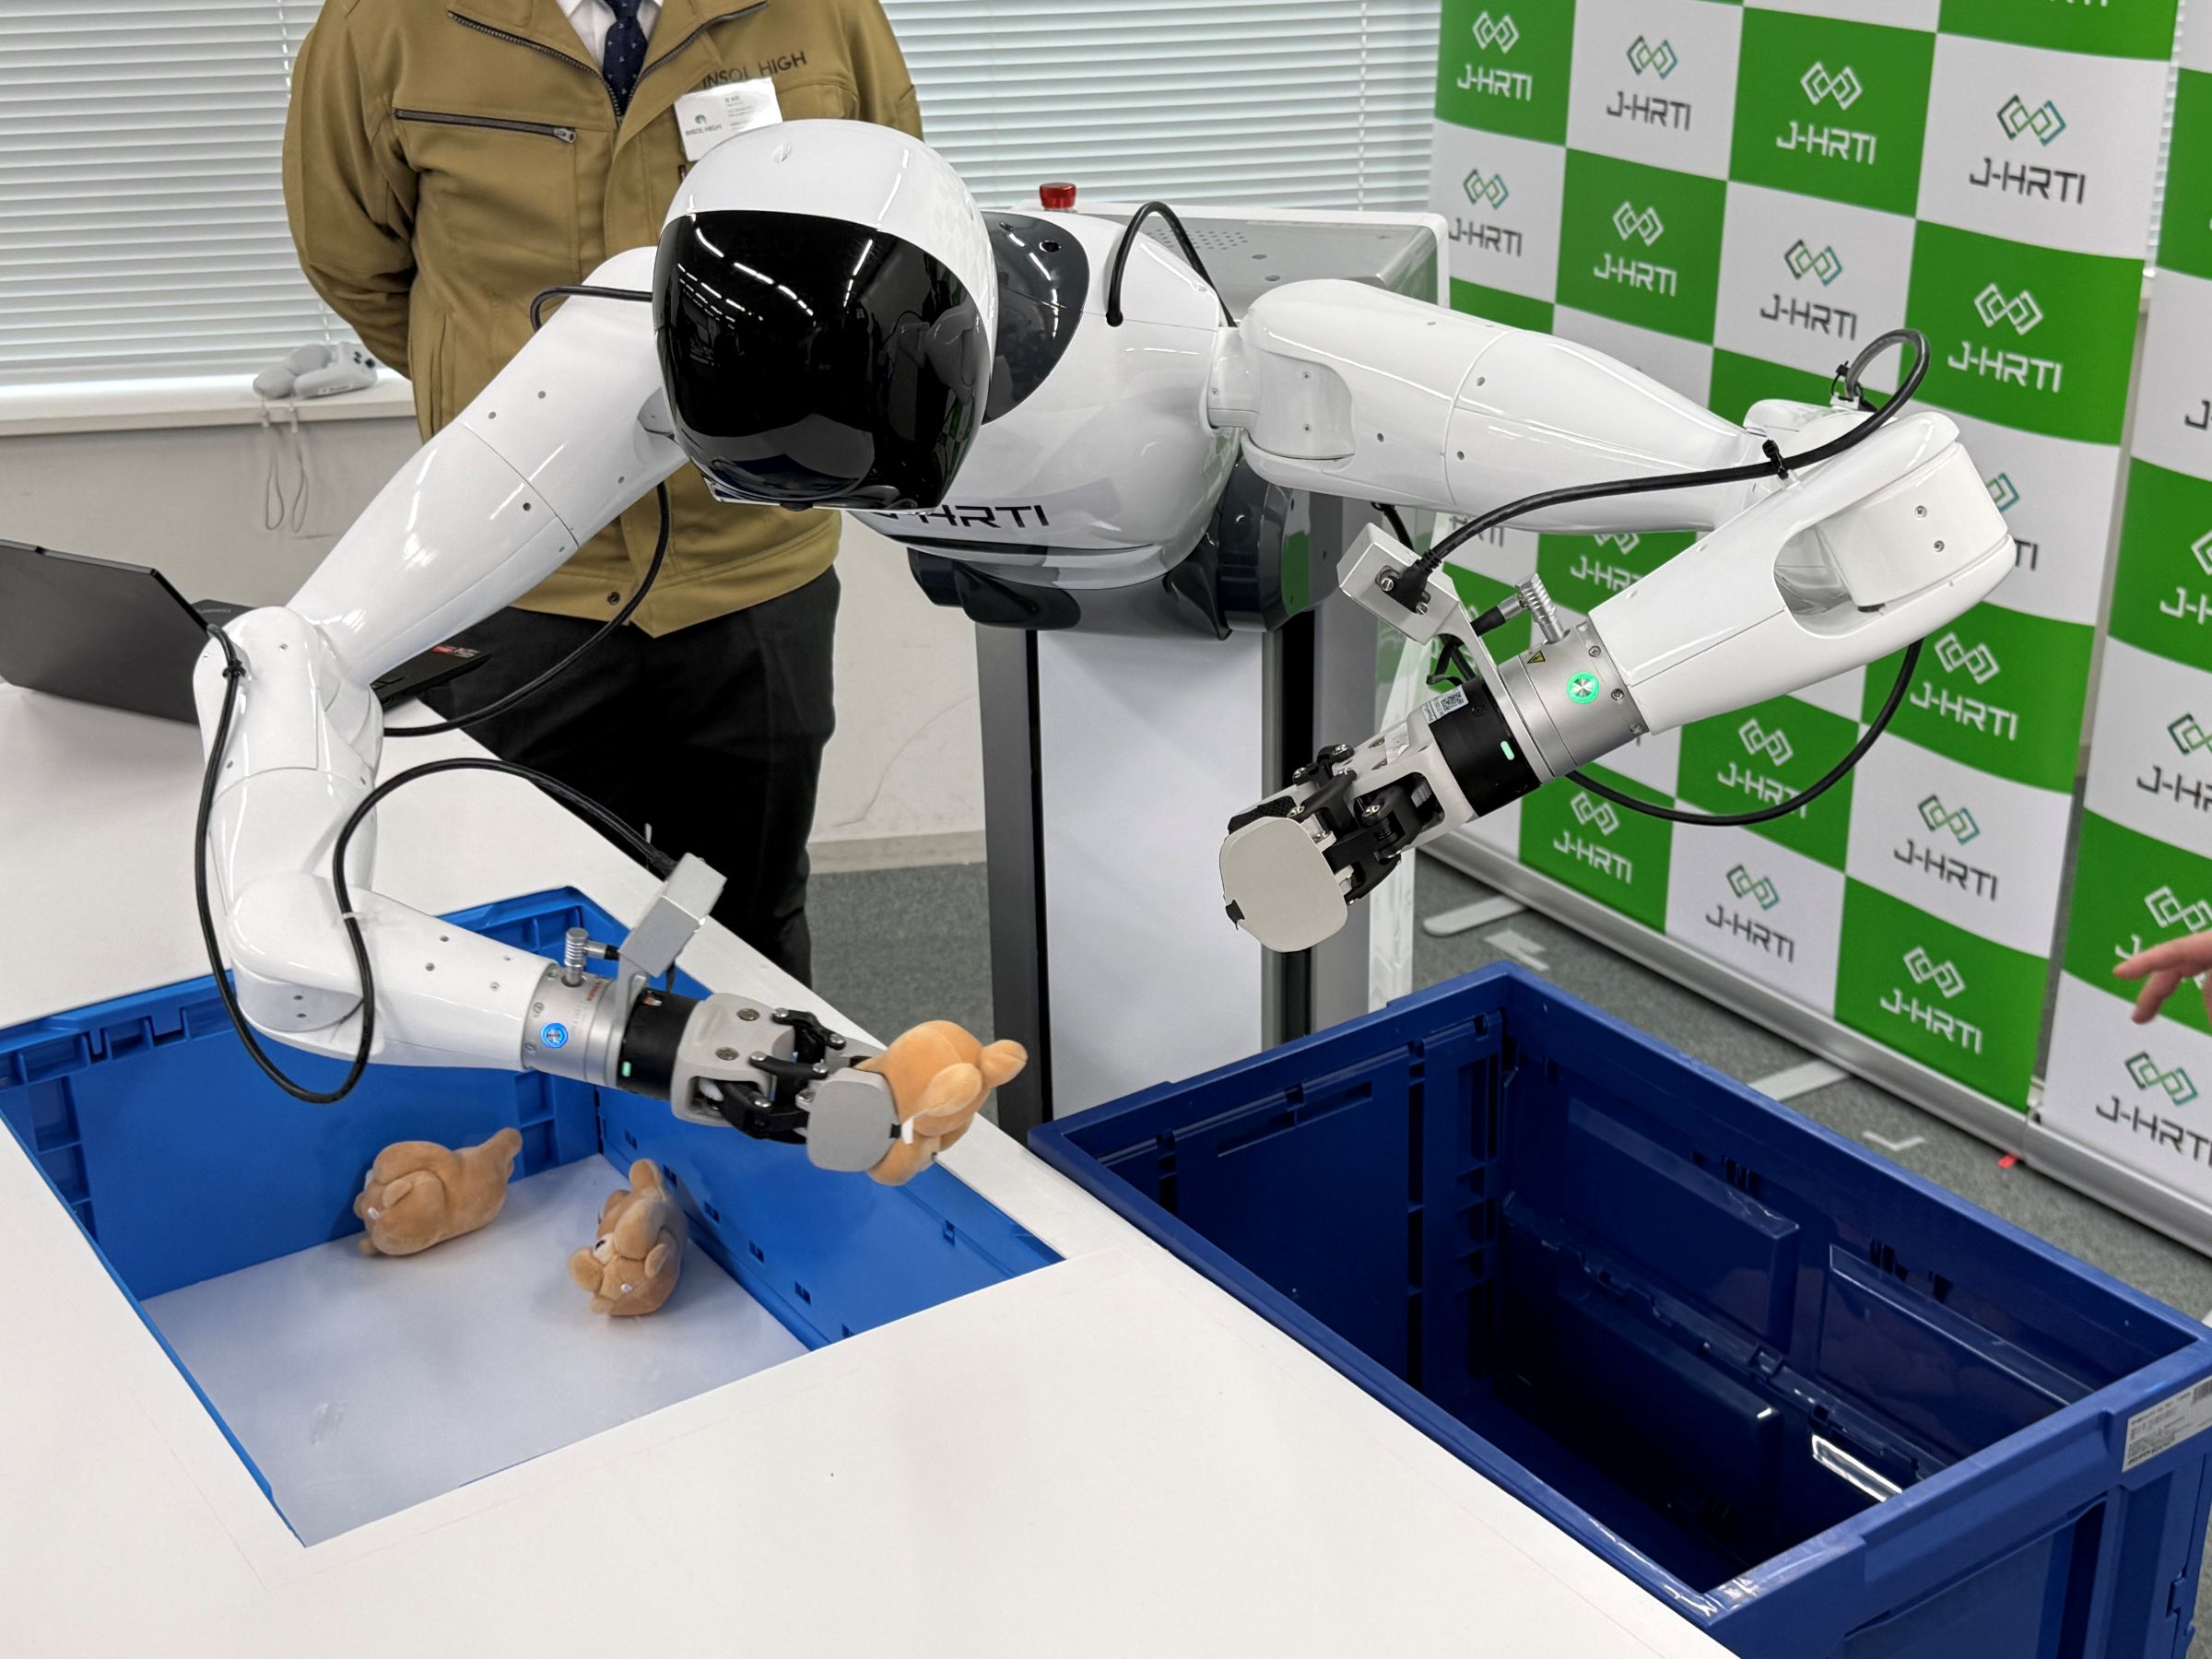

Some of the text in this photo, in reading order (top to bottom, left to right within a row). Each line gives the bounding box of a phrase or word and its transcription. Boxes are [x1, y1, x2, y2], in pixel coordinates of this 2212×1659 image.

[759, 52, 807, 76] HIGH
[1457, 65, 1532, 100] J-HRTI
[1606, 91, 1690, 130] J-HRTI
[1776, 122, 1876, 164] J-HRTI
[1970, 158, 2085, 204] J-HRTI
[1450, 218, 1522, 256] J-HRTI
[1594, 253, 1677, 296] J-HRTI
[1760, 295, 1856, 340] J-HRTI
[1948, 342, 2062, 393] J-HRTI
[871, 504, 1050, 529] HRTI
[1571, 555, 1642, 591] J-HR
[1911, 682, 2018, 741] J-HRTI
[1553, 830, 1632, 884] J-HRTI
[1894, 840, 1998, 900] J-HRTI
[1705, 904, 1794, 963] J-HRTI
[1880, 989, 1983, 1054] J-HRTI
